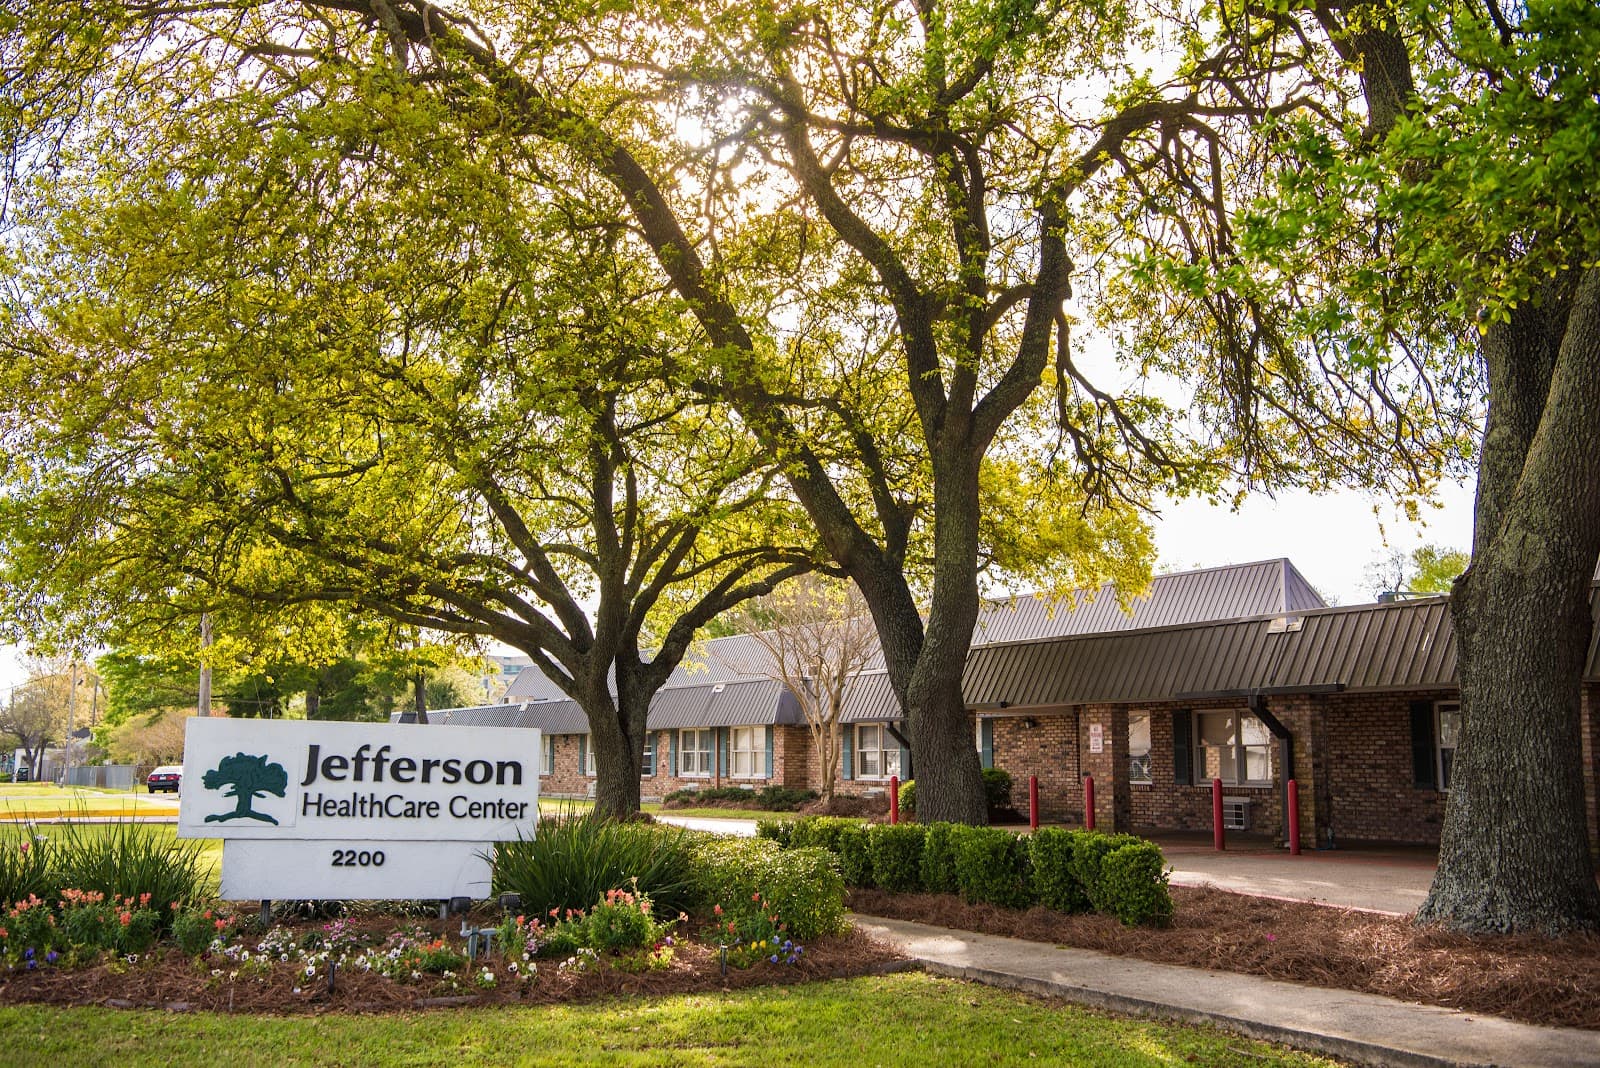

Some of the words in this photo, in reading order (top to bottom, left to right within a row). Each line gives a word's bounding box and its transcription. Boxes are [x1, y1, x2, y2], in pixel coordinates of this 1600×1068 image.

[301, 744, 522, 786] Jefferson
[302, 792, 440, 819] HealthCare
[449, 795, 528, 820] Center
[331, 850, 386, 867] 2200
